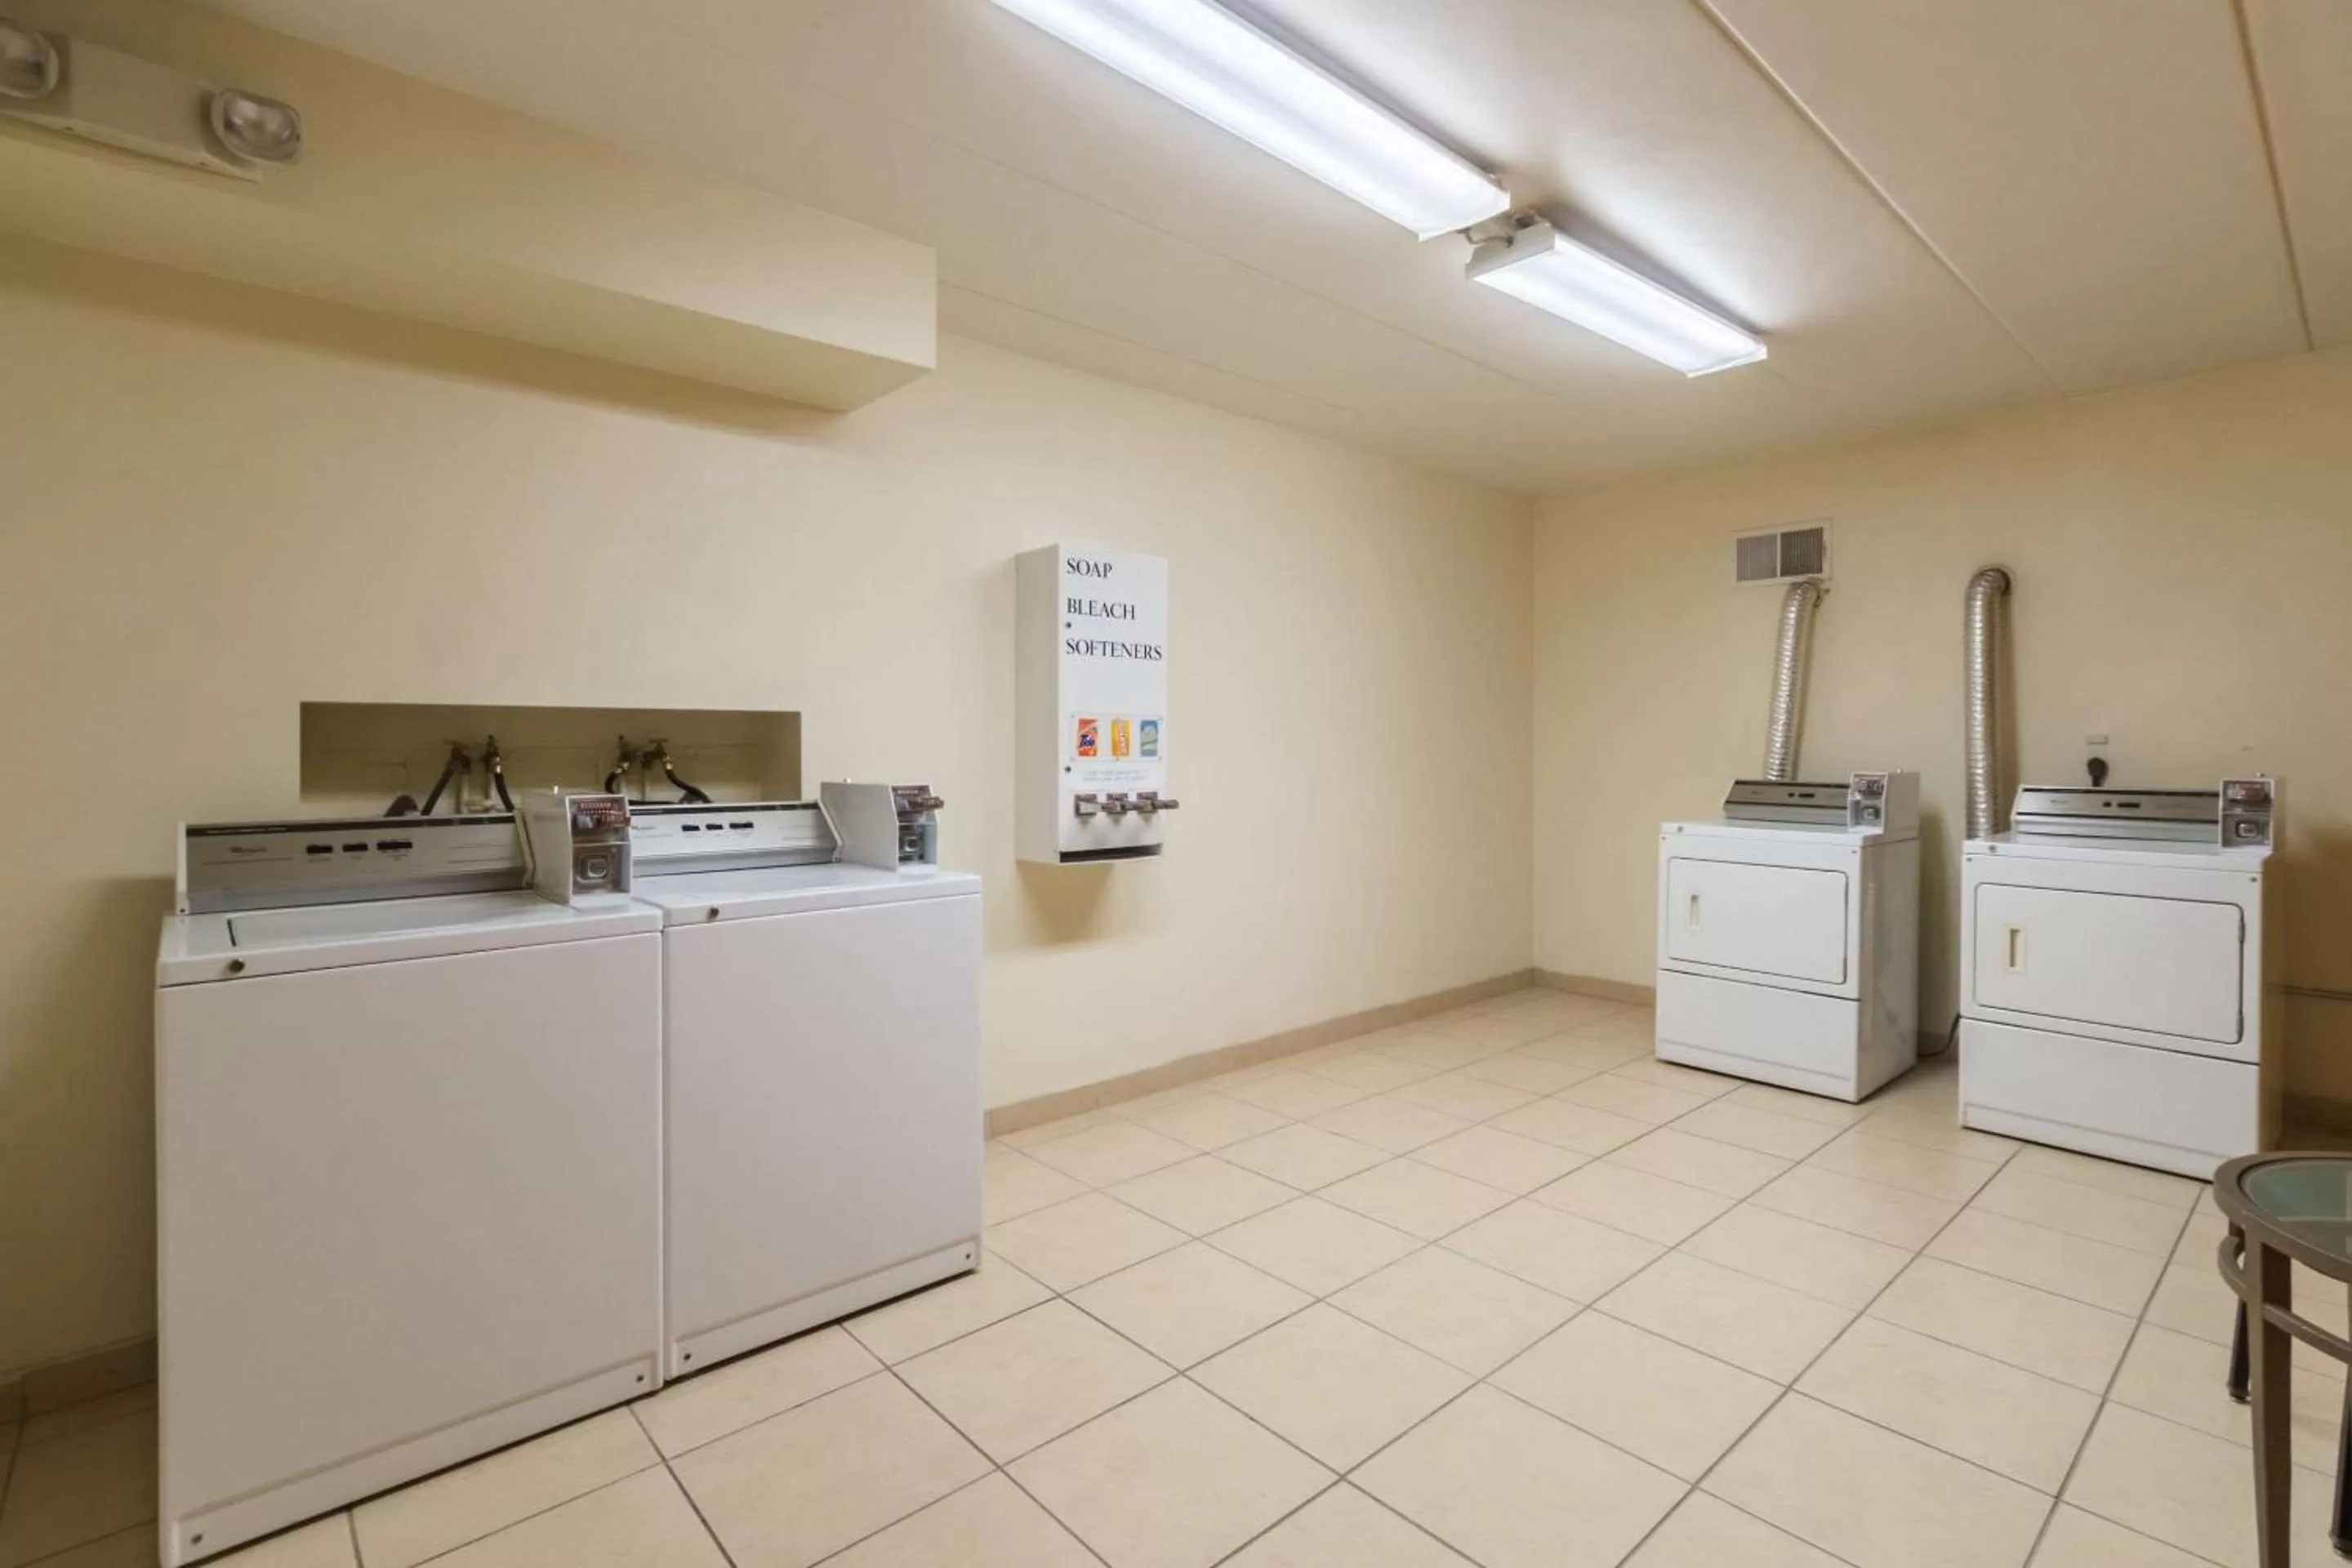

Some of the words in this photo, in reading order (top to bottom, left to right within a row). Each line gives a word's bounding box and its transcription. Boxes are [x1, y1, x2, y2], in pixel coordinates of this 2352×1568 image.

[1067, 558, 1112, 578] SOAP
[1067, 598, 1135, 620] BLEACH
[1066, 638, 1162, 661] SOFTENERS
